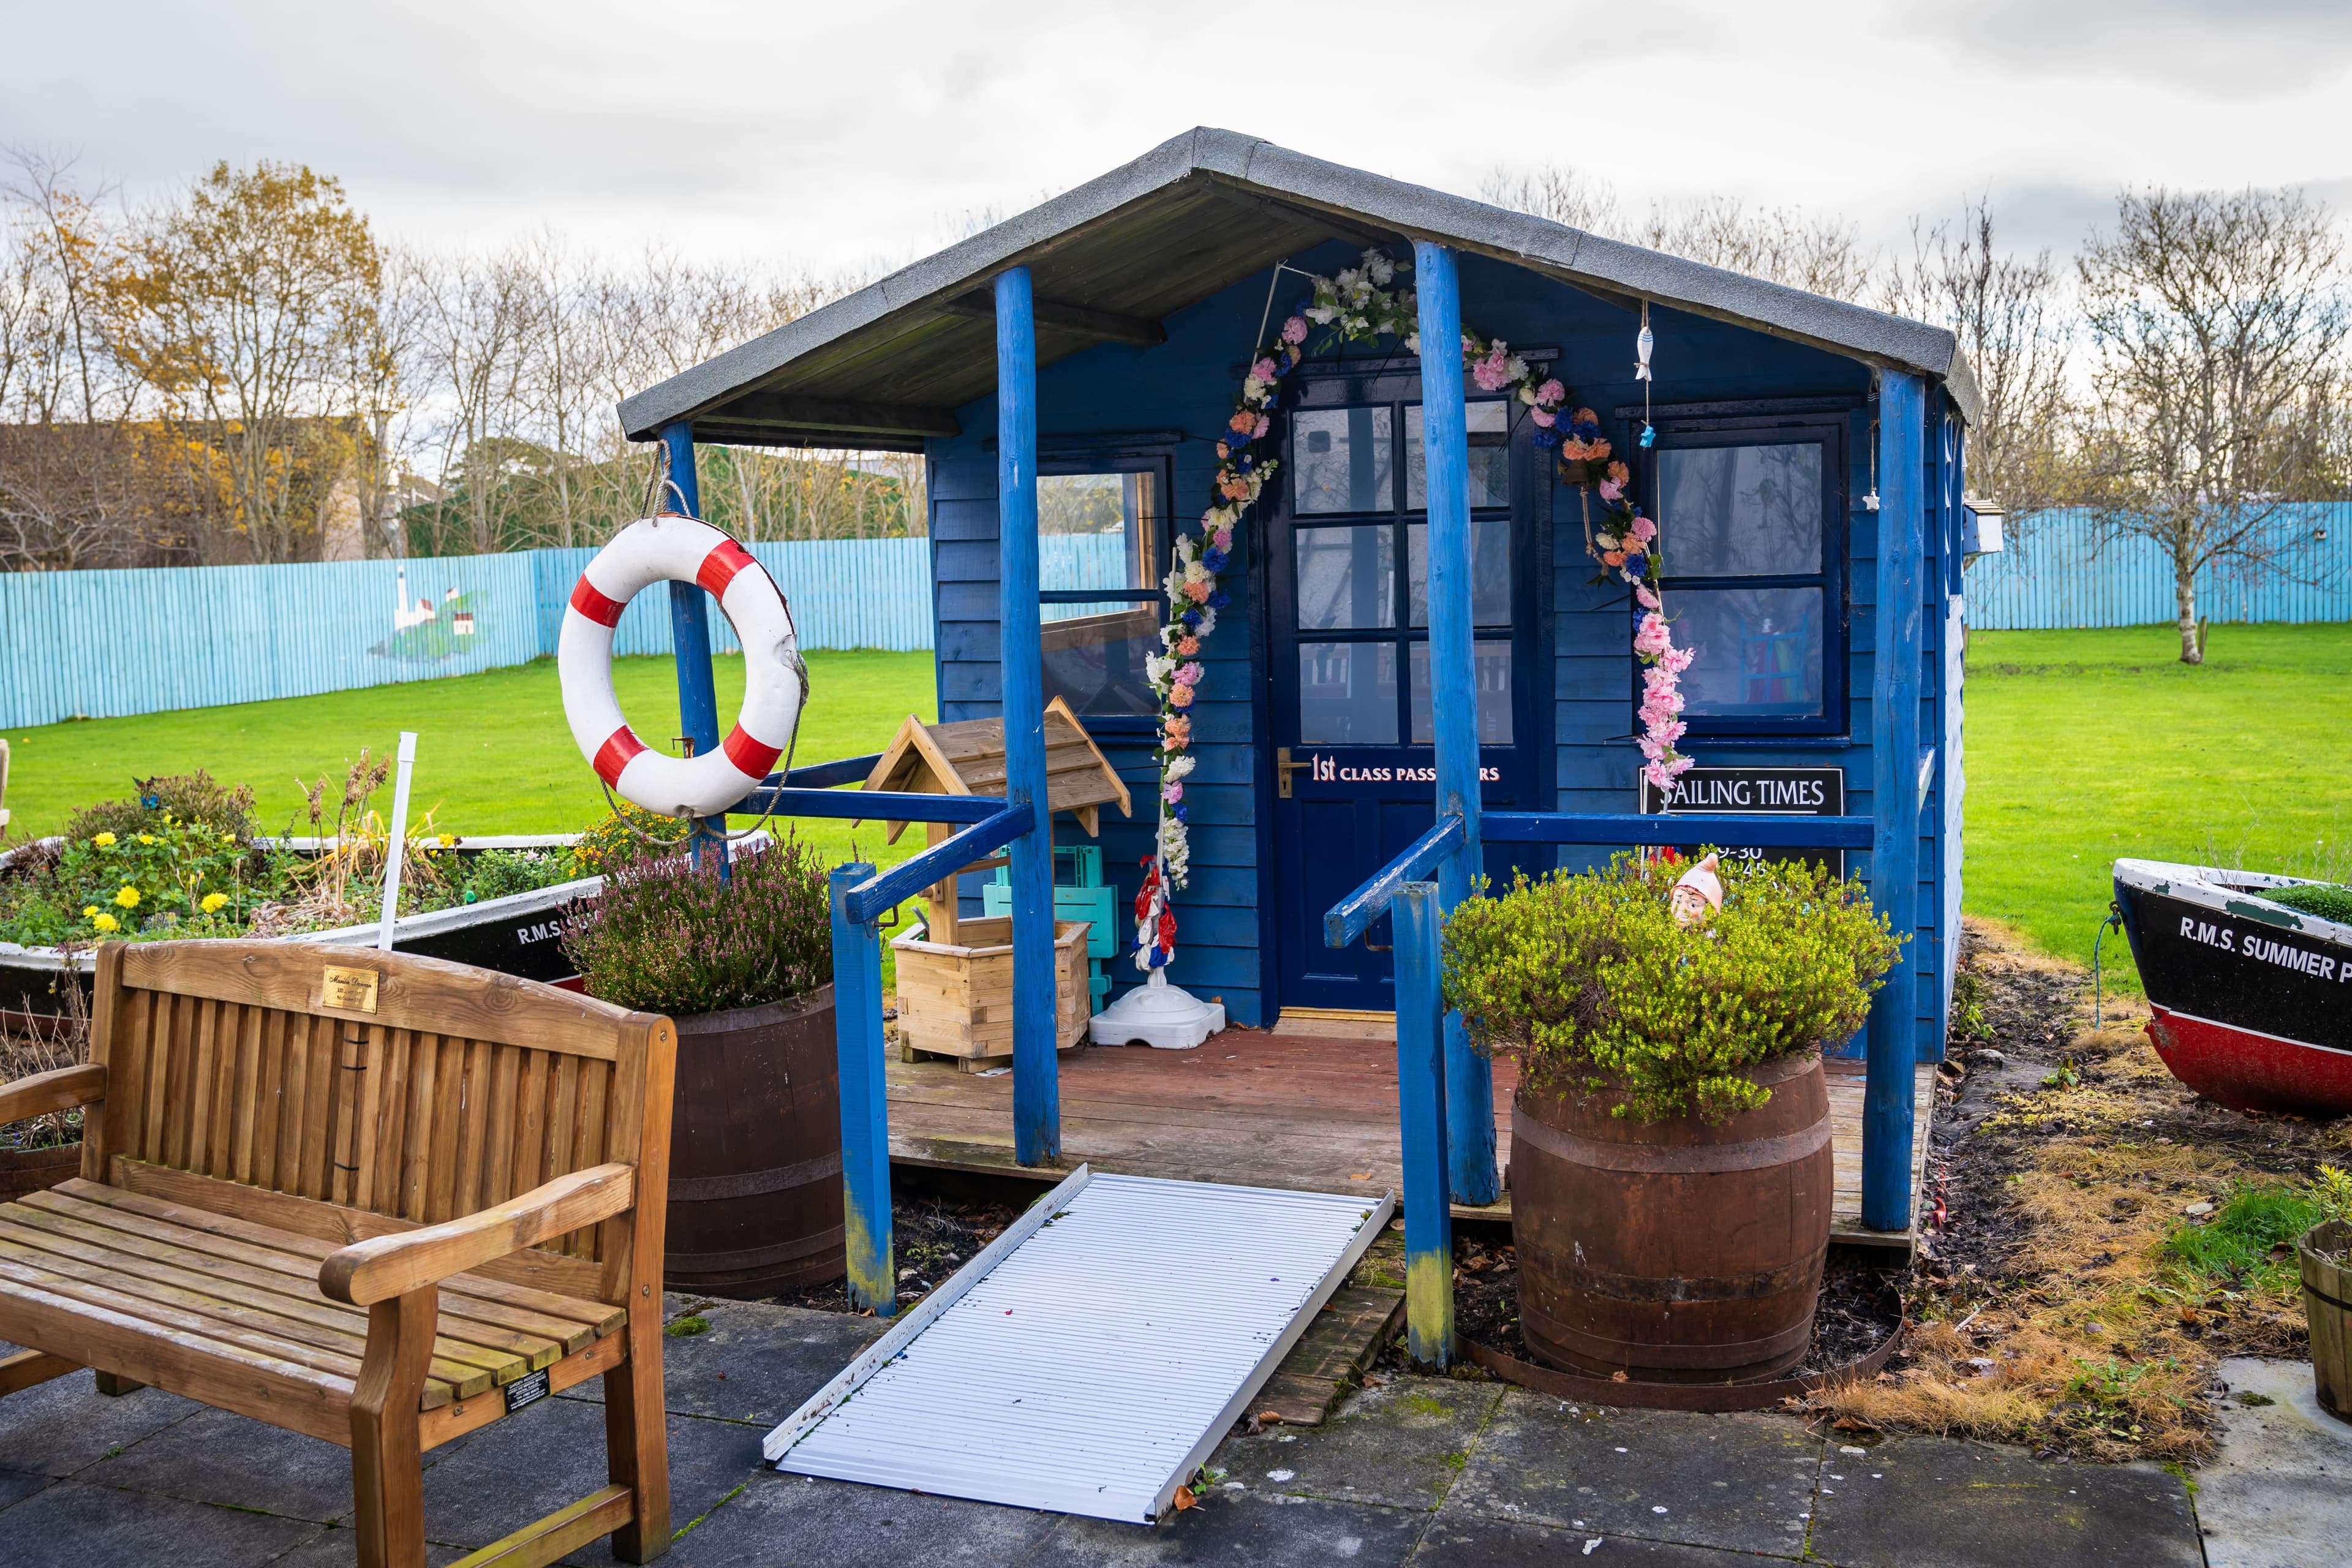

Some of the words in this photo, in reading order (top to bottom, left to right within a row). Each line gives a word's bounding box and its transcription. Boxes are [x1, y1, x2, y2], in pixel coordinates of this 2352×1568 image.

[1312, 753, 1335, 781] 1st
[1340, 767, 1392, 782] CLASS
[1396, 767, 1500, 782] PASSRS
[1756, 780, 1825, 805] TIMES
[2180, 916, 2236, 952] R.M.S.
[2242, 935, 2335, 980] SUMMER
[524, 1370, 544, 1382] WOODCRAFT
